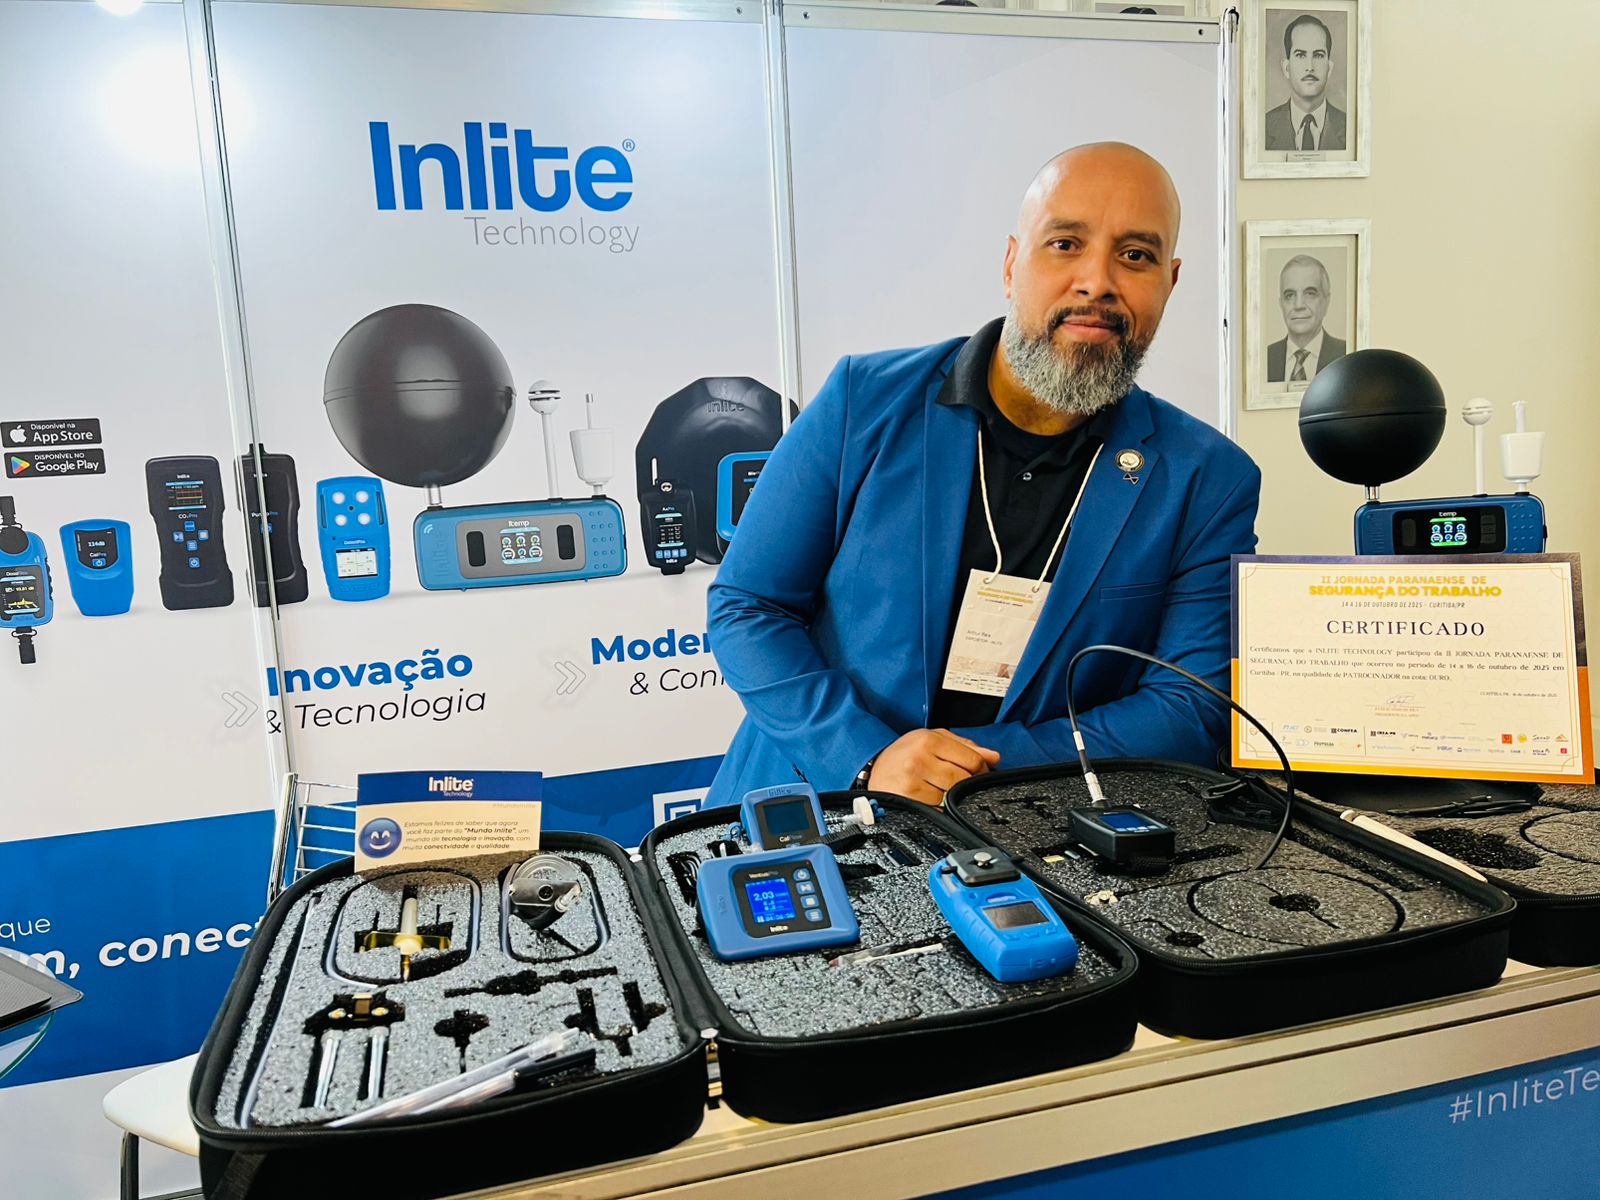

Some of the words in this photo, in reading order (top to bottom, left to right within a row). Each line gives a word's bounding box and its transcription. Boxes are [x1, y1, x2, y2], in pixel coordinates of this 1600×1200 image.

[464, 216, 640, 254] Technology
[33, 432, 59, 444] App
[60, 430, 93, 441] Store
[35, 460, 76, 473] Google
[76, 460, 100, 471] Play
[1322, 576, 1331, 584] II
[1334, 576, 1385, 584] JORNADA
[1389, 576, 1465, 584] PARANAENSE
[1472, 576, 1487, 584] DE
[1310, 586, 1396, 599] SEGURANÇA
[1398, 586, 1420, 596] DO
[1423, 586, 1502, 597] TRABALHO
[1326, 620, 1485, 636] CERTIFICADO
[1344, 648, 1392, 656] TECHNOLOGY
[1396, 648, 1431, 657] participou
[1456, 650, 1491, 658] JORNADA
[1250, 657, 1293, 666] SEGURANÇA
[266, 648, 473, 696] Inovação
[1343, 672, 1400, 680] PATROCINADOR
[630, 672, 649, 696] &
[266, 709, 282, 734] &
[294, 688, 486, 729] Tecnologia
